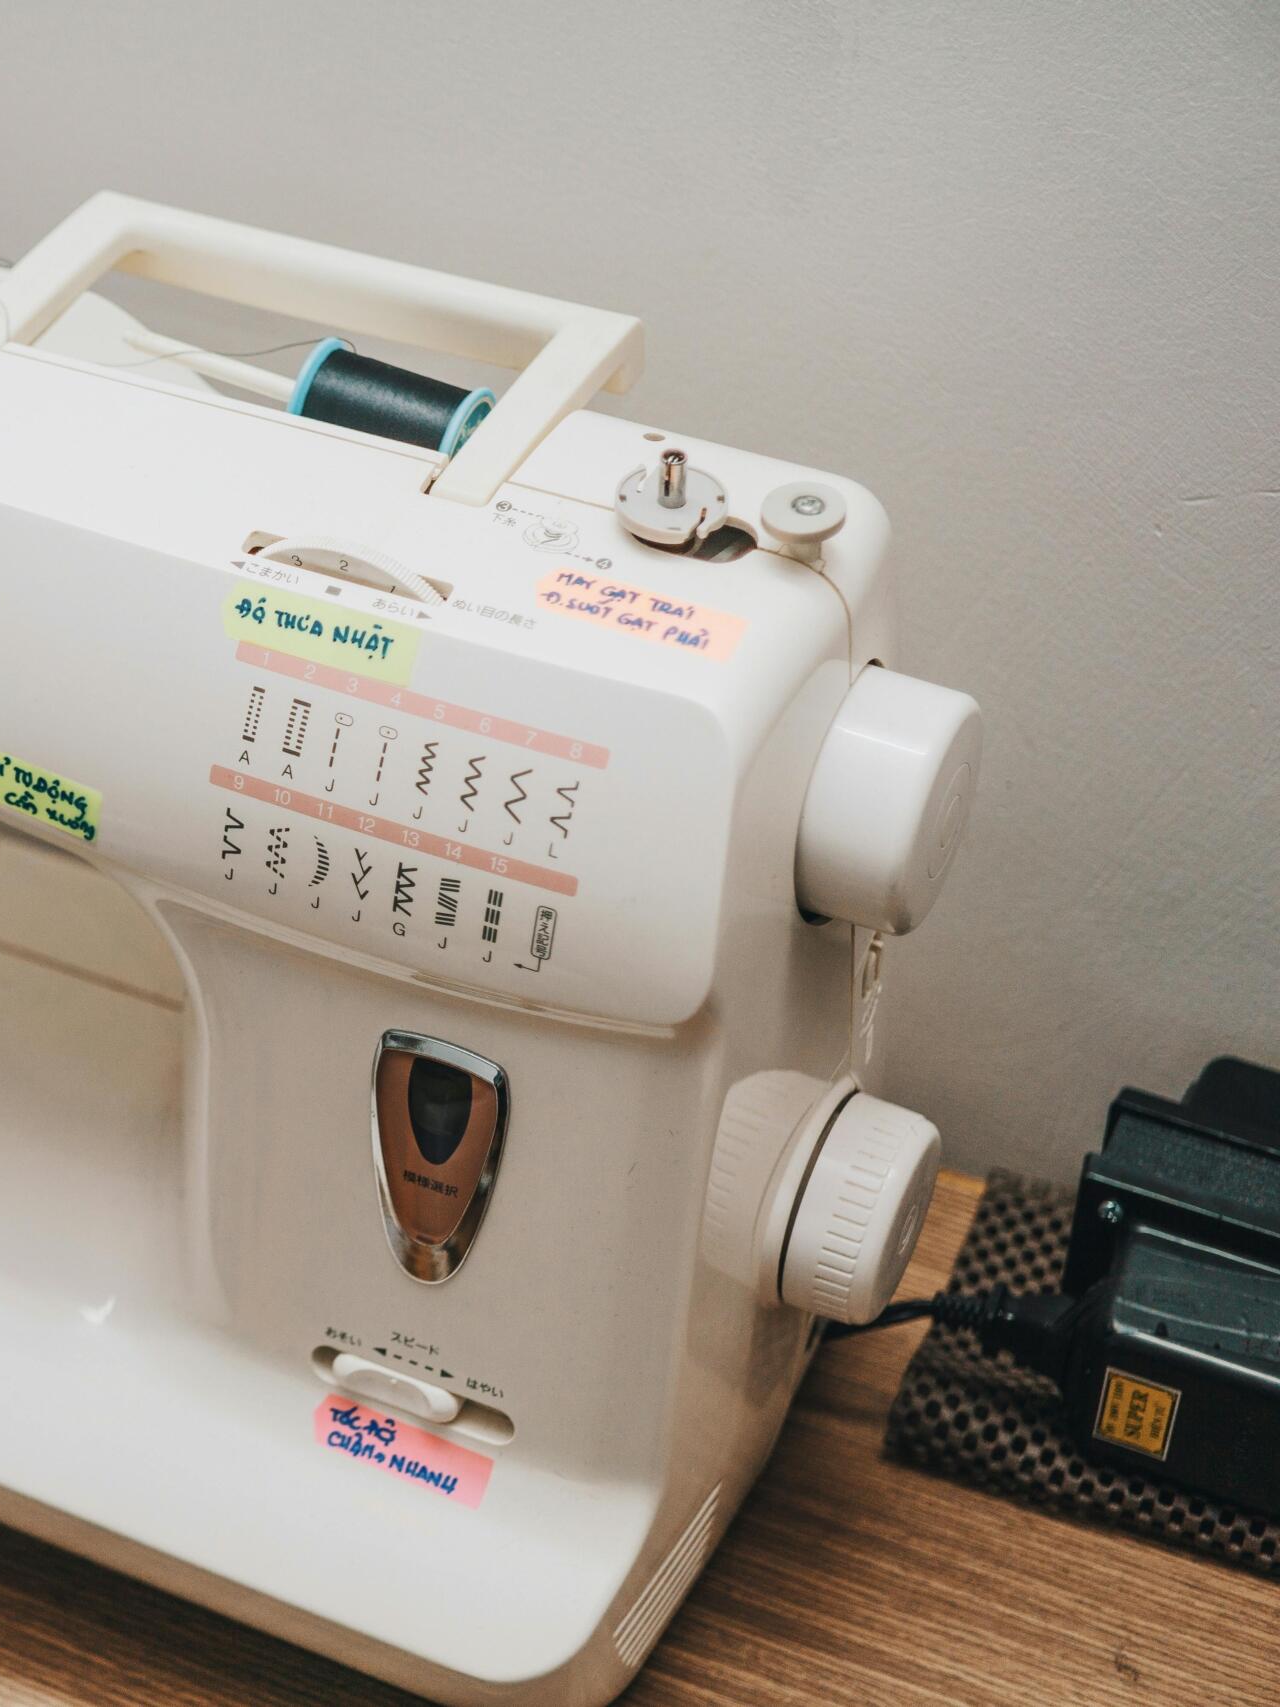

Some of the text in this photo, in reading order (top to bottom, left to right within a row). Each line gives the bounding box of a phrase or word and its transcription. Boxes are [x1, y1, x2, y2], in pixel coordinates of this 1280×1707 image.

[245, 561, 300, 586] こまかい
[291, 554, 304, 568] 3
[339, 559, 350, 572] 2
[303, 664, 316, 680] 2
[346, 677, 359, 693] 3
[391, 692, 402, 706] 4
[433, 704, 446, 719] 5
[479, 717, 492, 733] 6
[525, 730, 538, 746] 7
[569, 742, 583, 759] 8
[233, 775, 509, 873] 9 10 11 12 13 14 15
[238, 750, 558, 859] A A J J J J J L
[224, 868, 492, 963] J J J J G J J
[390, 1331, 440, 1356] スピード
[465, 1377, 504, 1399] はやい
